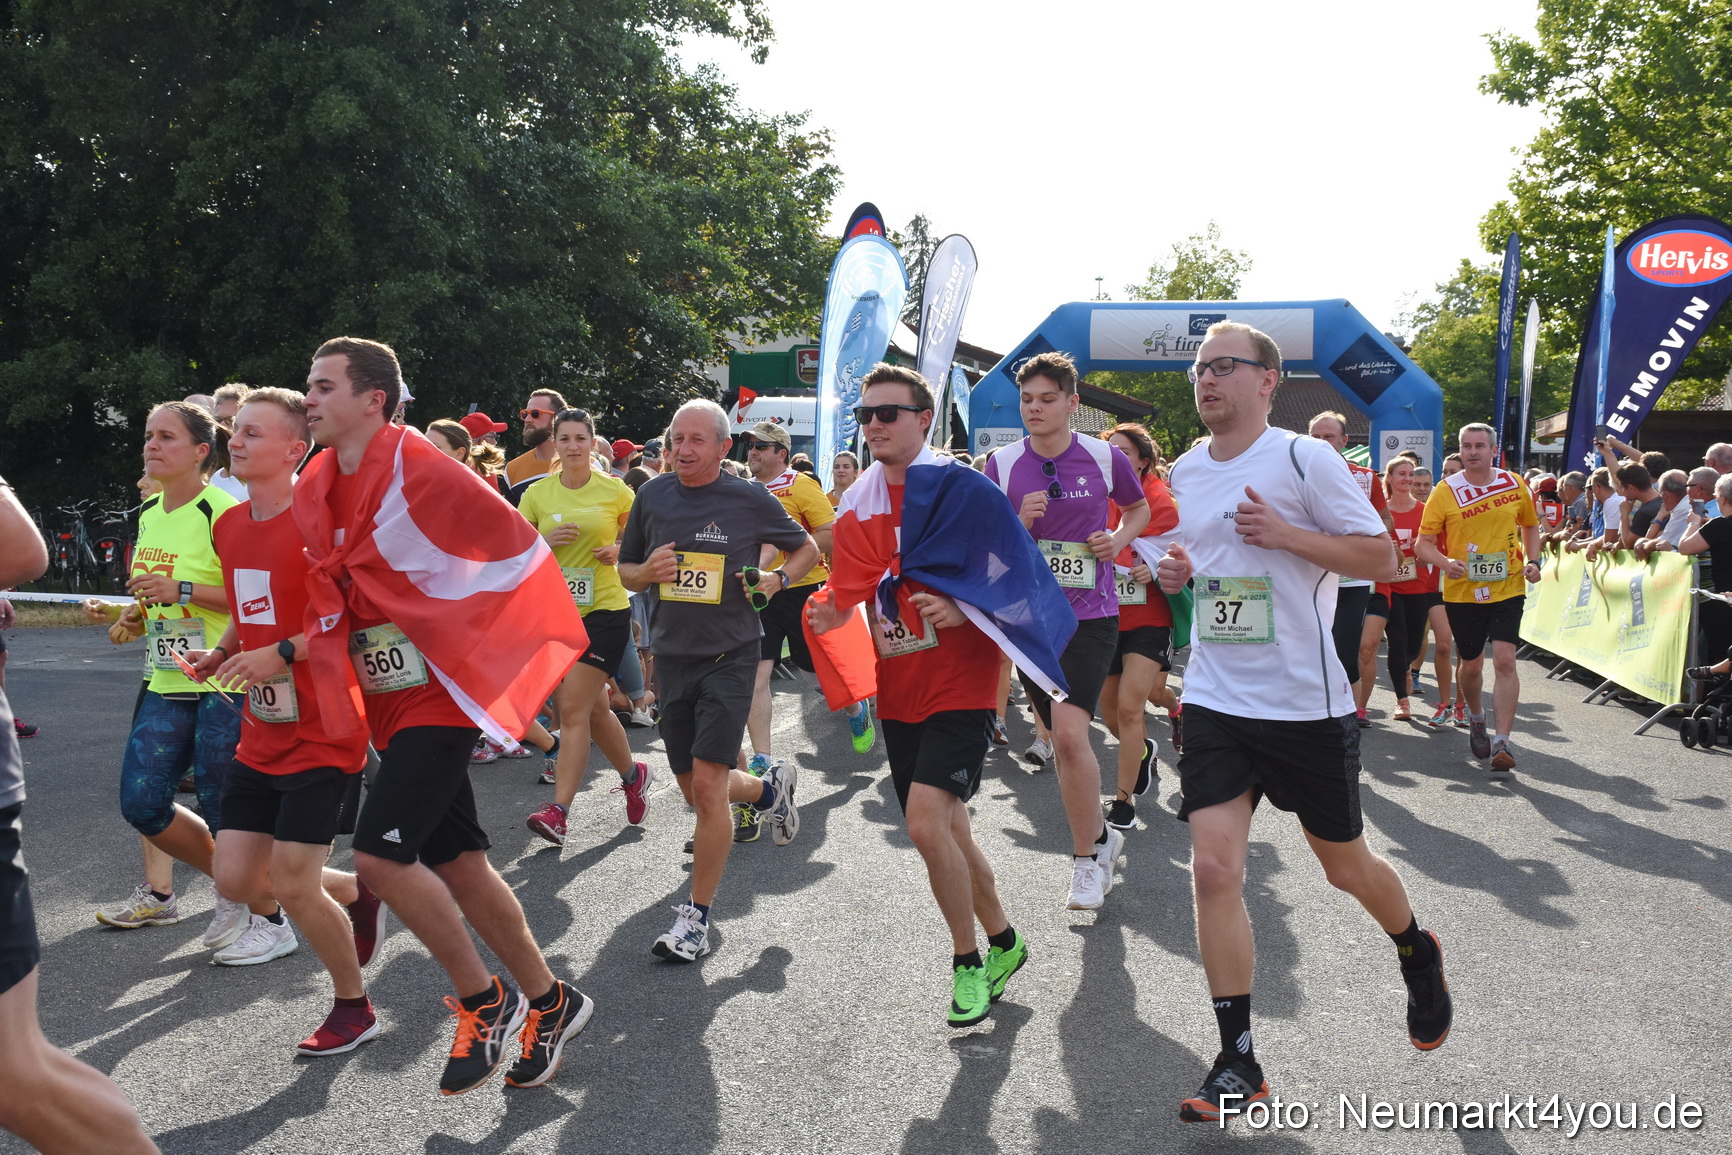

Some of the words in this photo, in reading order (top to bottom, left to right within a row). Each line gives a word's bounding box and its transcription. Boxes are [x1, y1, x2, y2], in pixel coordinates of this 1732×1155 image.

[1639, 243, 1729, 275] Hervis
[1650, 269, 1684, 277] SPORTS
[946, 263, 967, 327] AUTOMOBILE
[1070, 489, 1093, 498] LILA.
[1461, 502, 1491, 520] MAX
[1493, 493, 1521, 508] BÖGL
[136, 547, 179, 564] Müller
[1049, 557, 1084, 575] 883
[1472, 562, 1503, 575] 1676
[1214, 600, 1243, 625] 37
[157, 637, 190, 657] 673
[902, 637, 919, 645] Tobias
[362, 646, 405, 677] 560
[396, 669, 412, 678] Loris
